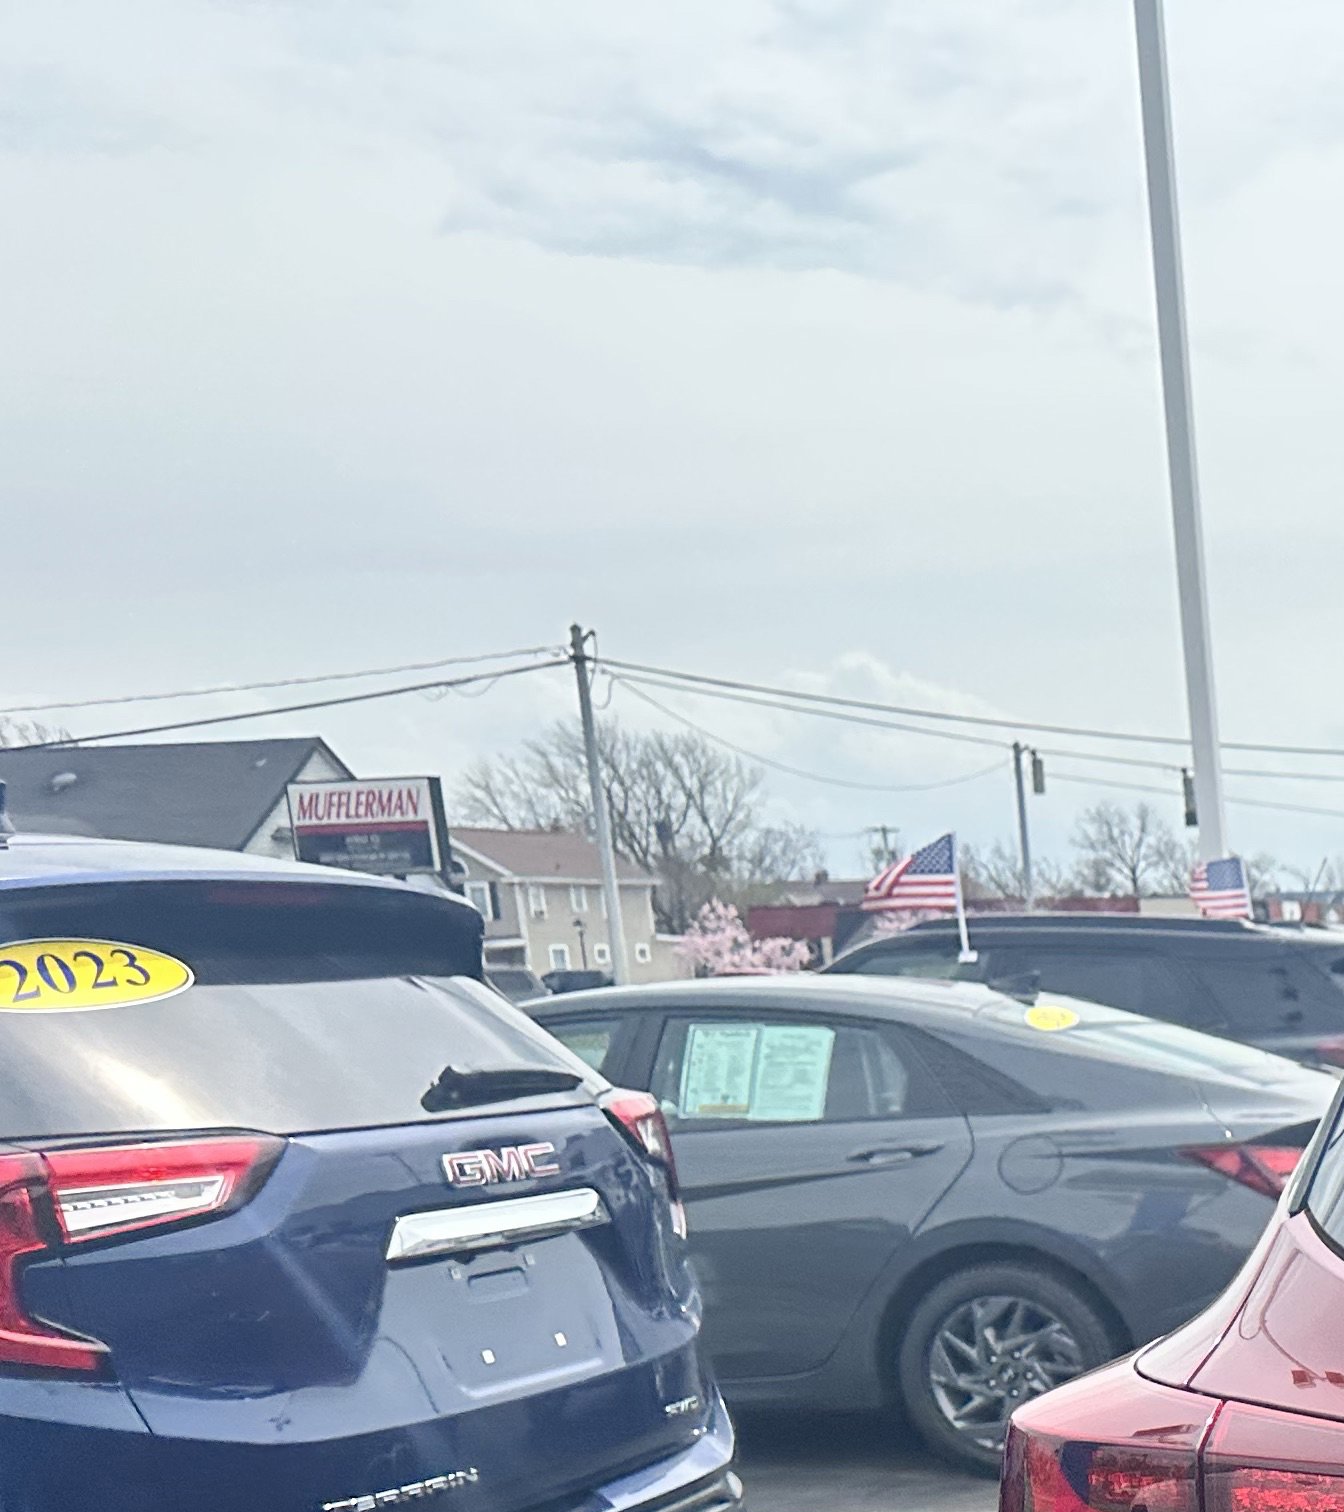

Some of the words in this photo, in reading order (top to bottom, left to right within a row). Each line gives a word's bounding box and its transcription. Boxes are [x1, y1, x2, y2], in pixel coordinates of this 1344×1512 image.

[297, 787, 420, 821] MUFFLERMAN
[0, 949, 150, 1002] 2023
[442, 1141, 561, 1188] GMC
